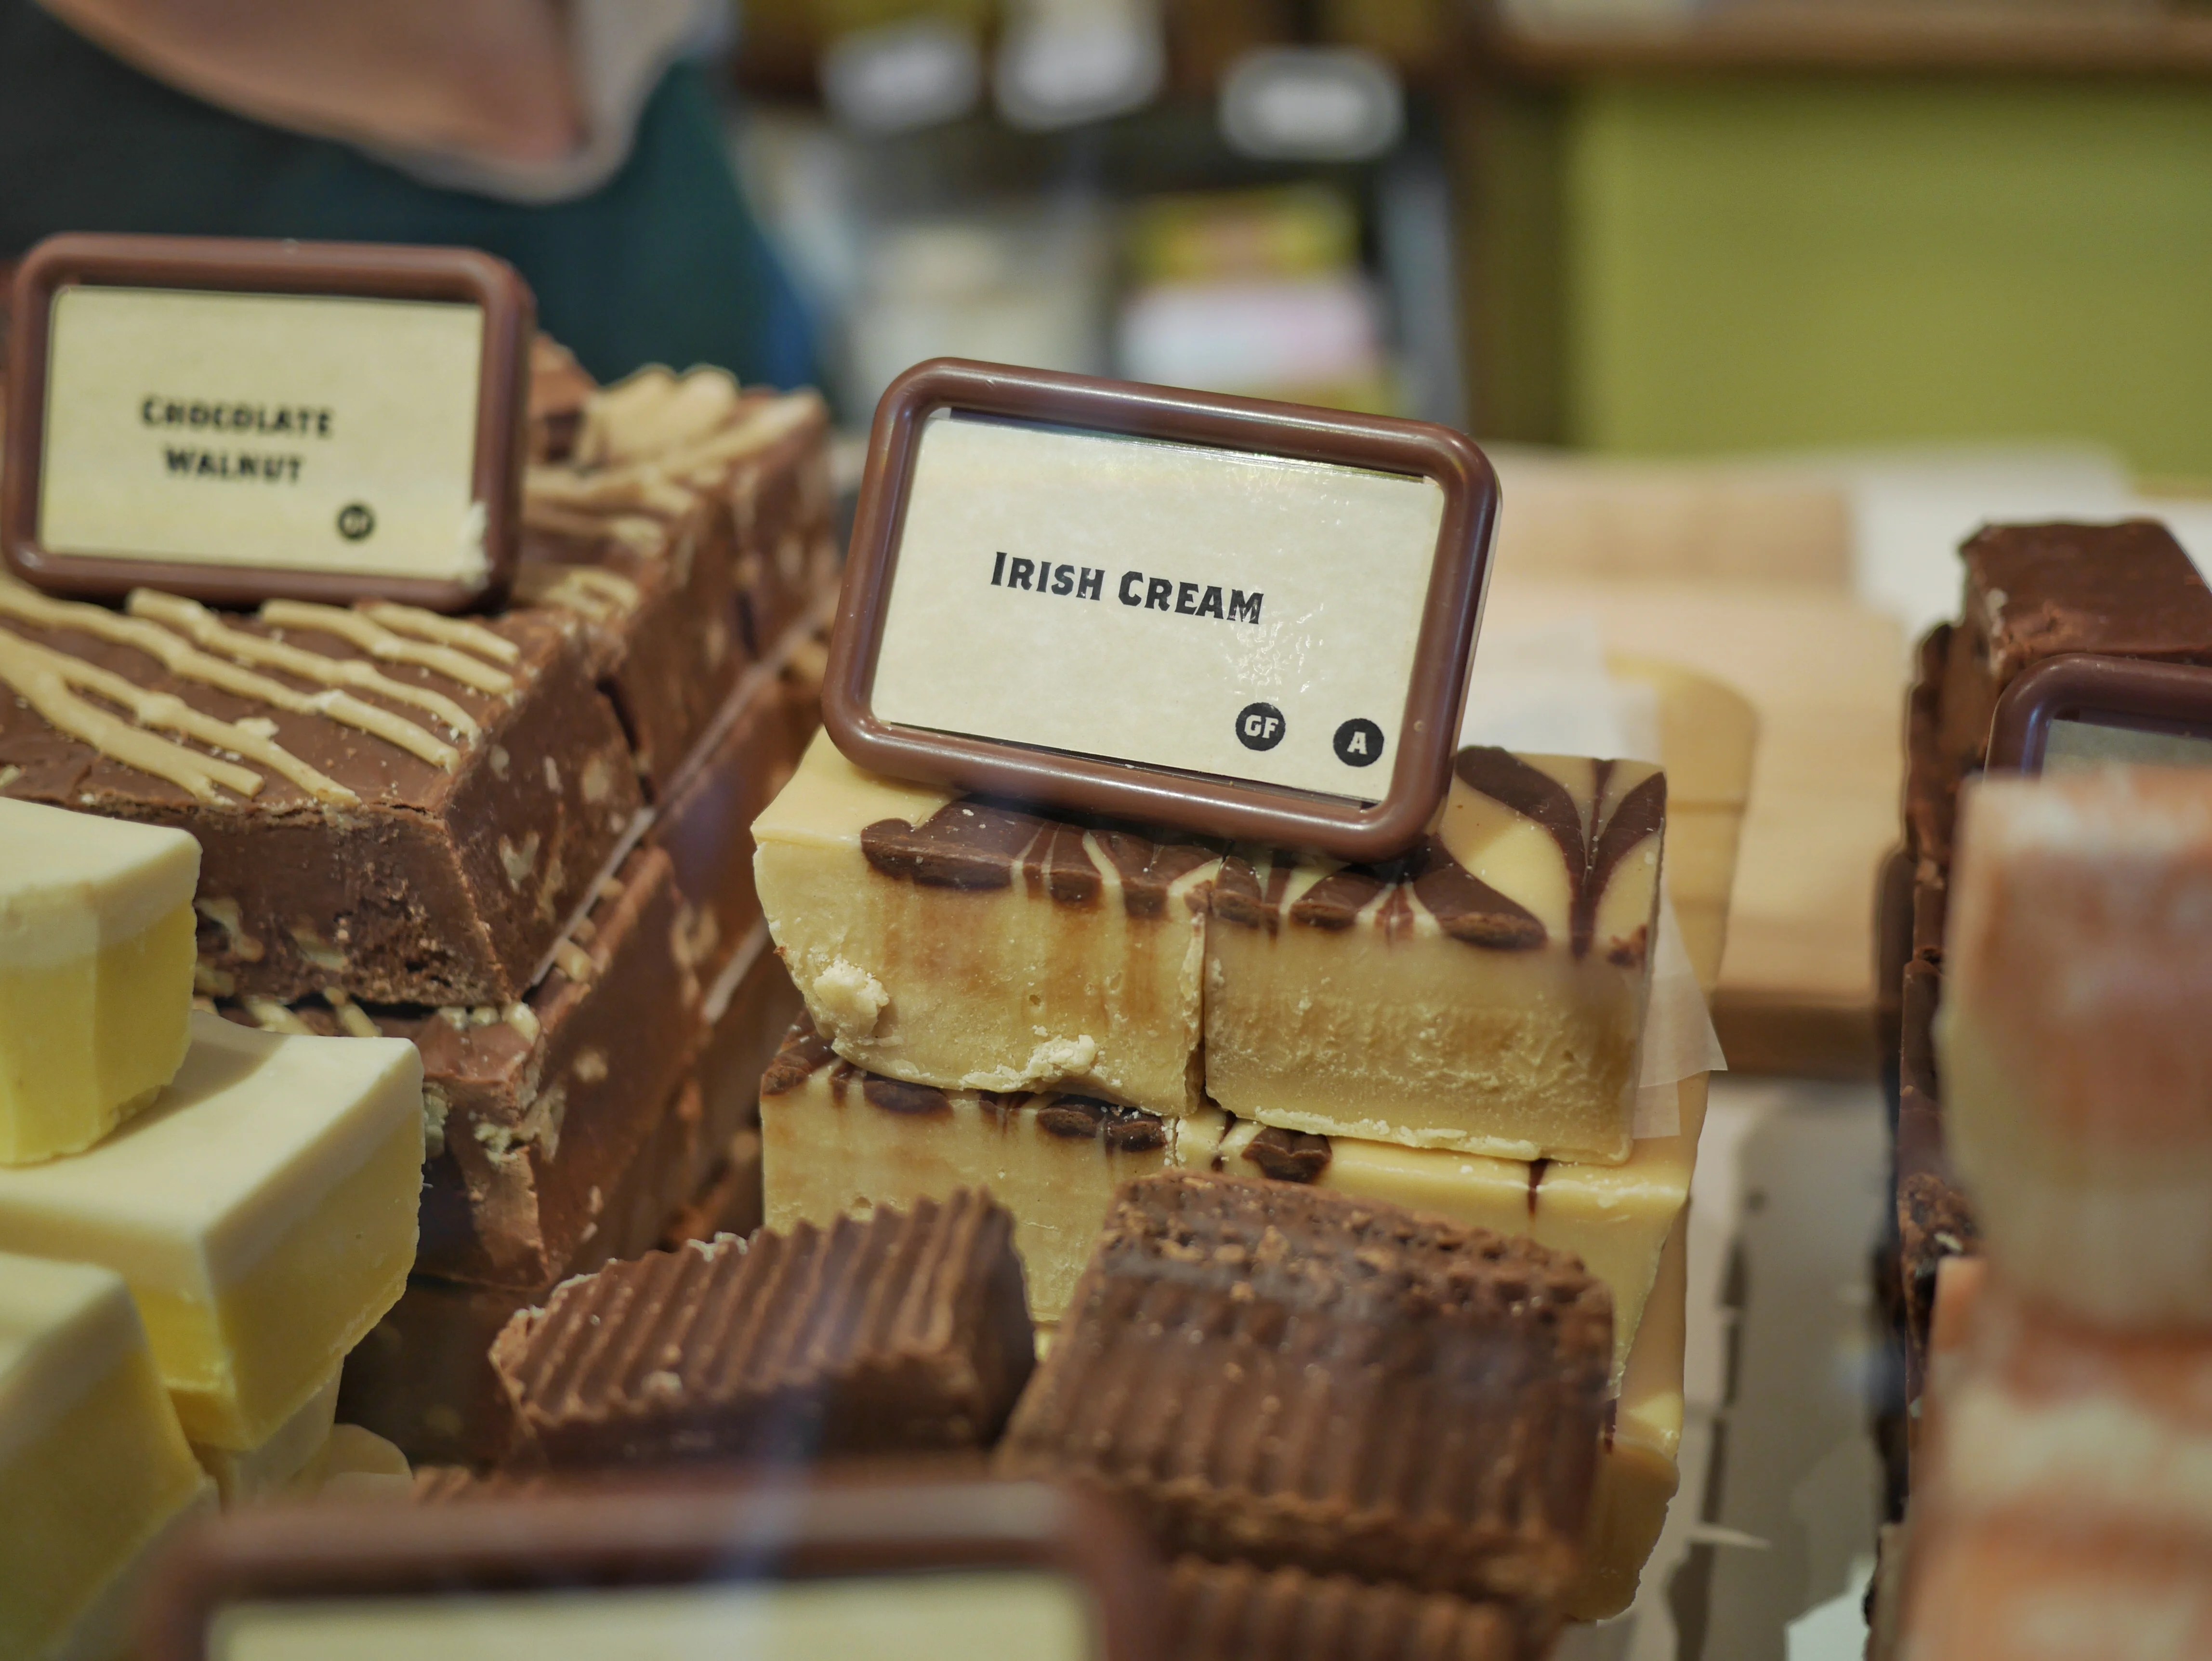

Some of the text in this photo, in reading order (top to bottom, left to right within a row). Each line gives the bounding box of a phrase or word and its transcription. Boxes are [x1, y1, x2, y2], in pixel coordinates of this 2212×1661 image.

[141, 396, 333, 437] CHOCOLATE
[165, 444, 303, 483] WALNUT
[991, 551, 1264, 625] IRISH CREAM
[1244, 714, 1368, 755] GF A
